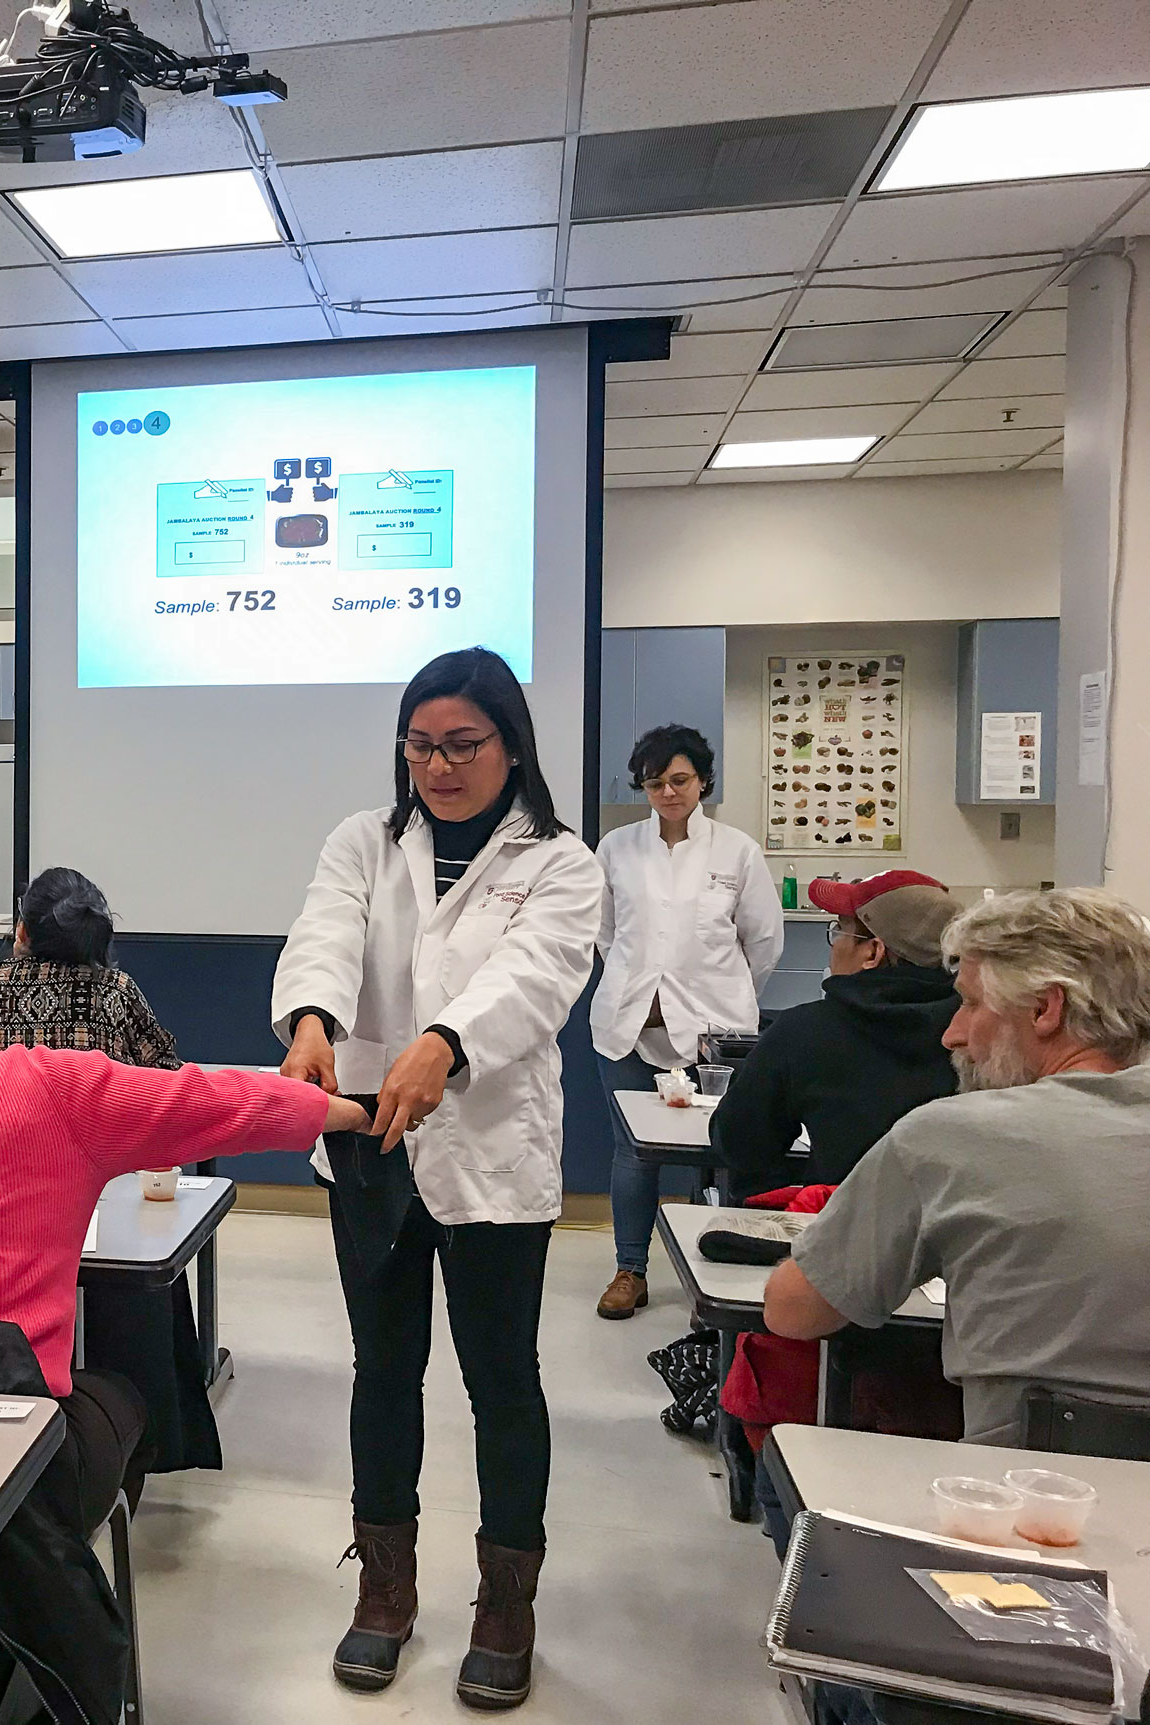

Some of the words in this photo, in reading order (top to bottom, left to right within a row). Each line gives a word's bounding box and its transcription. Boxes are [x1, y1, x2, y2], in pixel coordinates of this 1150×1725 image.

[151, 416, 161, 430] 4
[399, 520, 415, 528] 319
[214, 528, 229, 536] 752
[154, 600, 220, 616] Sample:
[226, 589, 276, 612] 752
[332, 596, 401, 613] Sample:
[407, 586, 462, 609] 319
